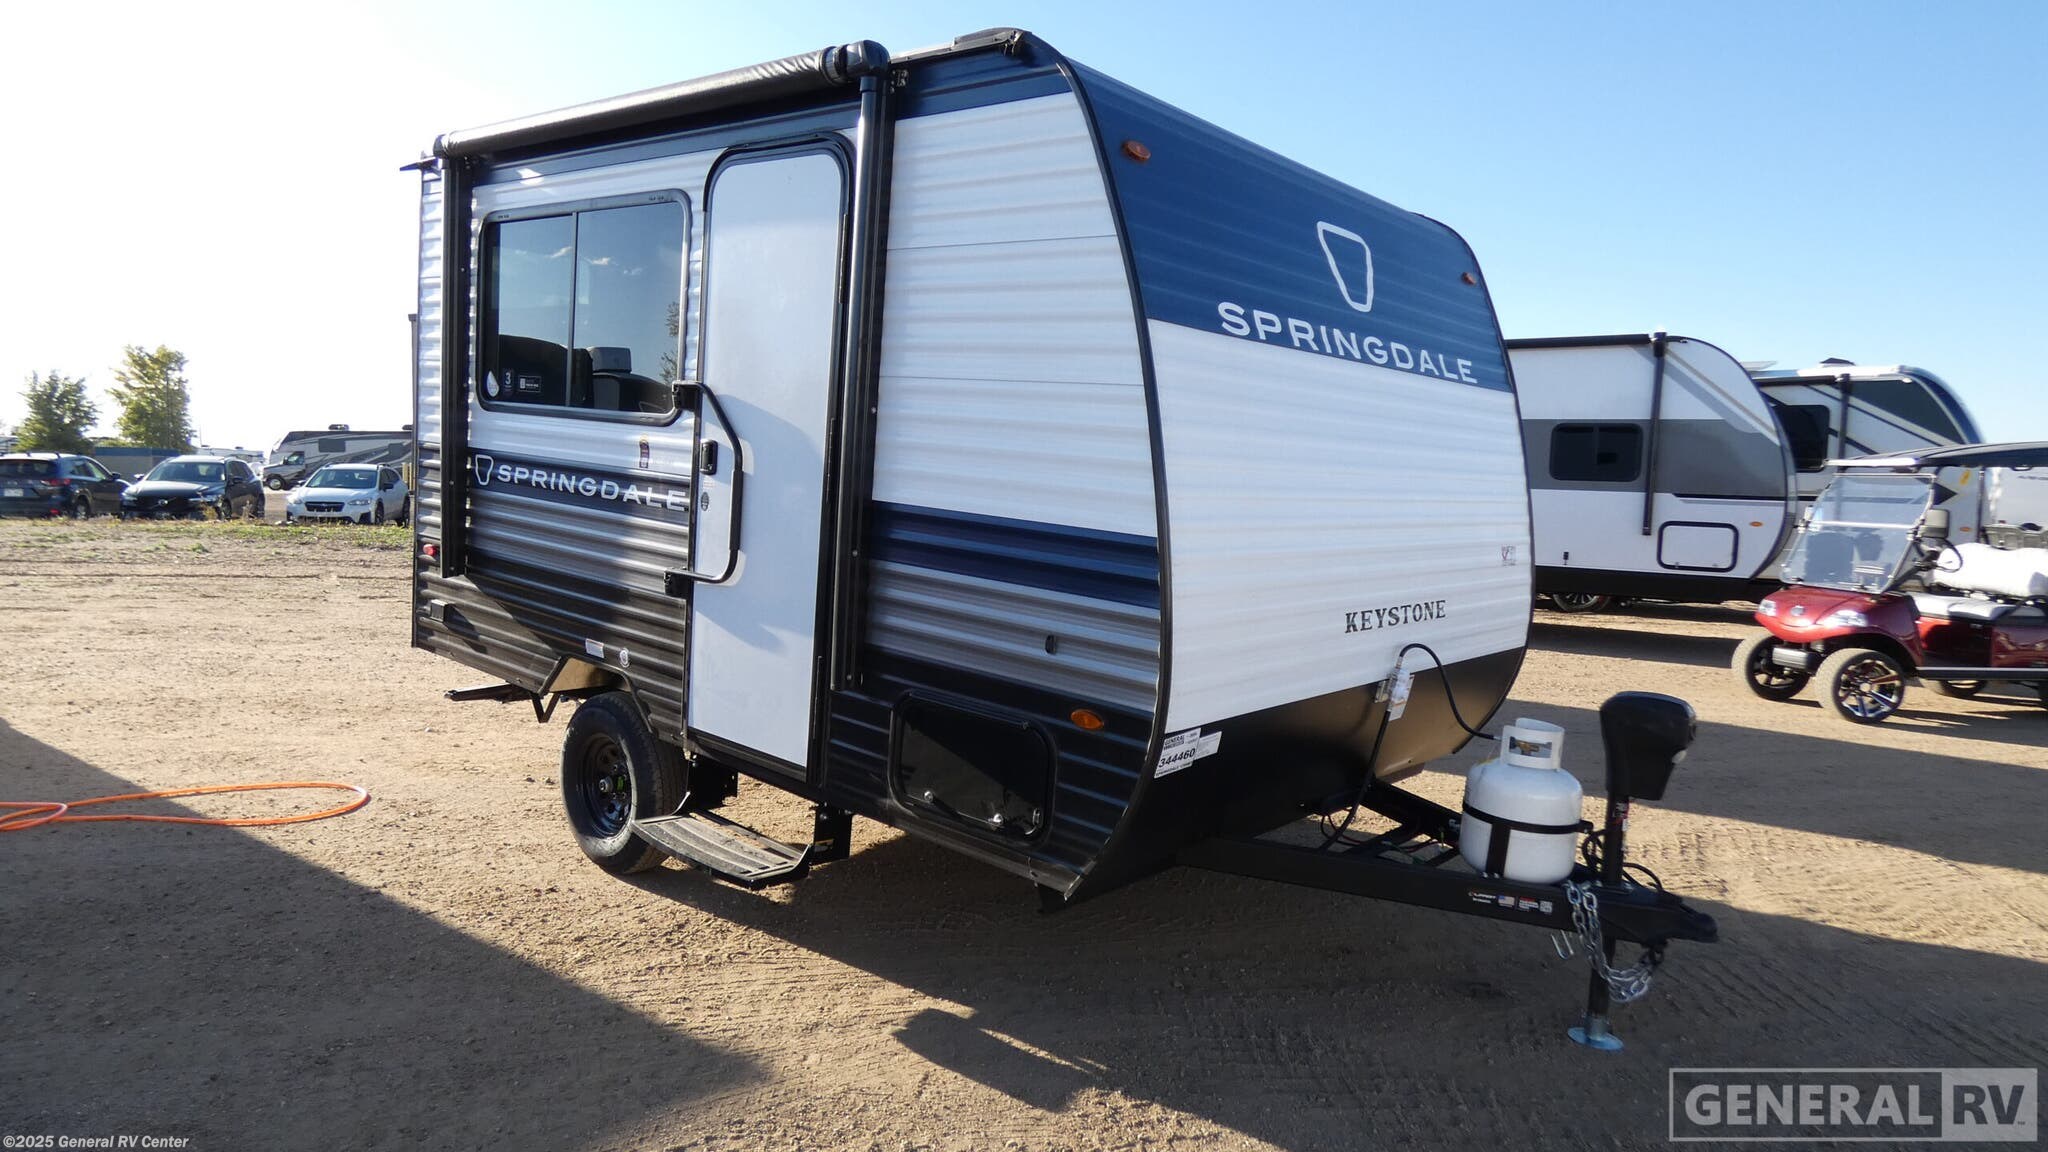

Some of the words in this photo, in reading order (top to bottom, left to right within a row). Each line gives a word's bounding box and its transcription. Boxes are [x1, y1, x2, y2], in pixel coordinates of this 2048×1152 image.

[1217, 301, 1478, 384] SPRINGDALE
[497, 464, 687, 511] SPRINGDALE
[1344, 600, 1446, 634] KEYSTONE
